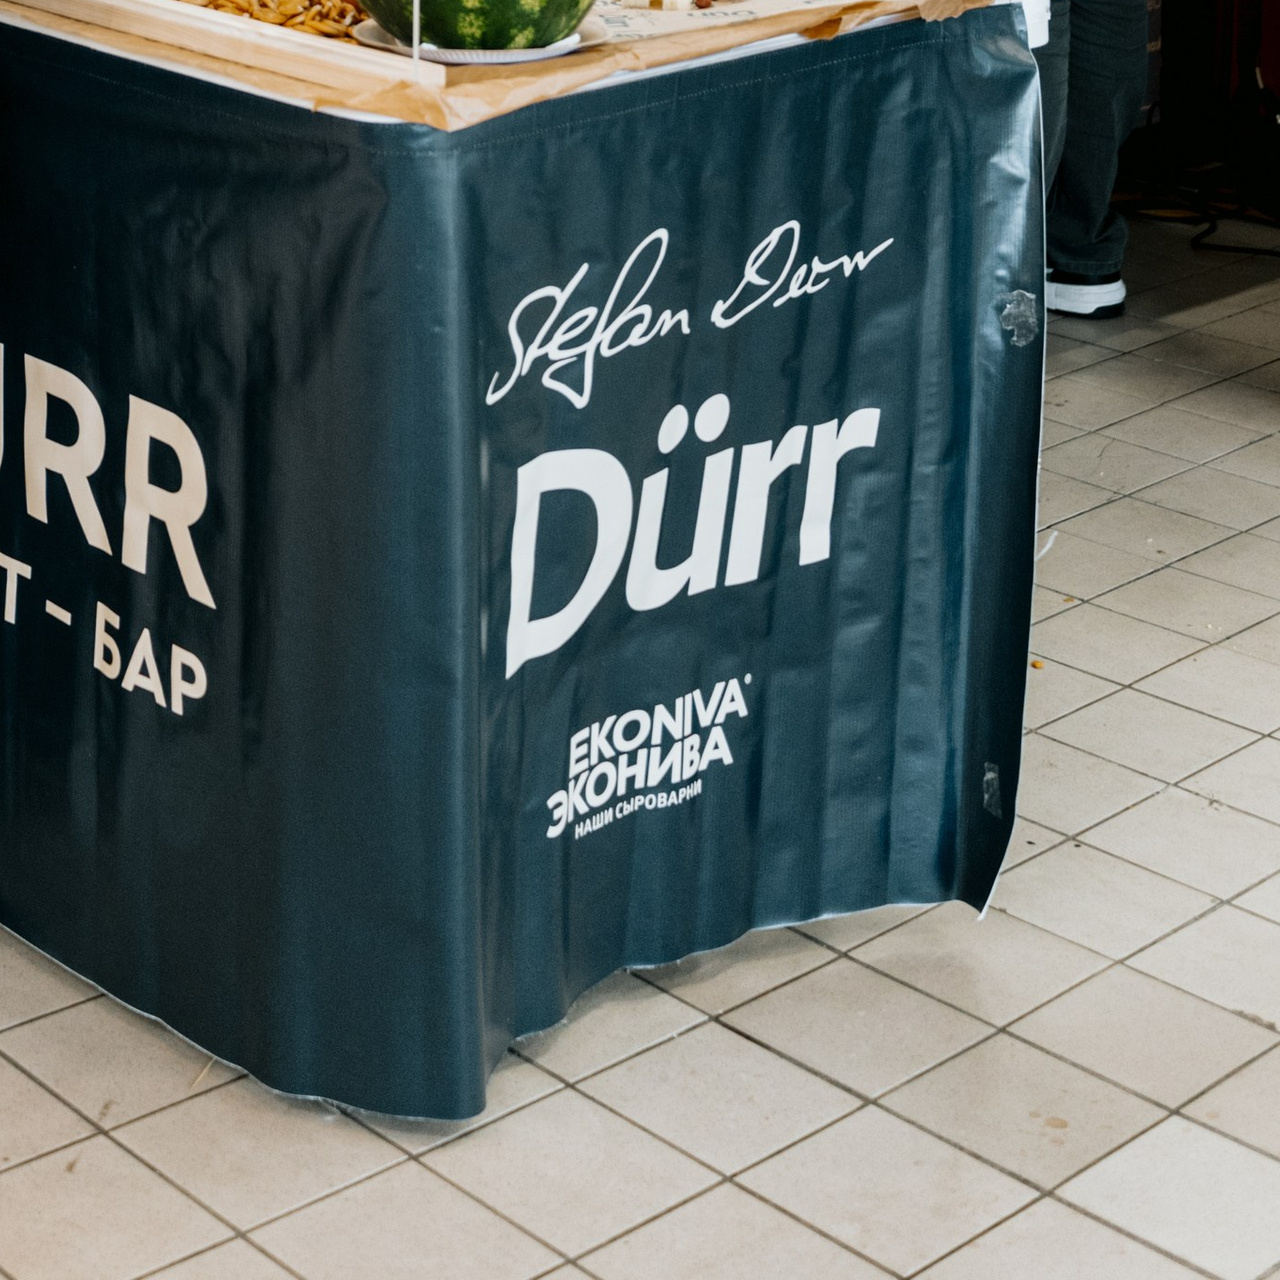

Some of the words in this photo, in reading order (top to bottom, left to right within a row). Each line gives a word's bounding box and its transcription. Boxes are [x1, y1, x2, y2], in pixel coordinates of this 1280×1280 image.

[505, 392, 881, 680] Dürr
[93, 600, 208, 717] БАР
[546, 725, 734, 839] ЭКОНИВА
[568, 677, 749, 780] EKONIVA
[574, 806, 614, 840] НАШИ
[614, 777, 703, 819] СЫРОВАРНИ
